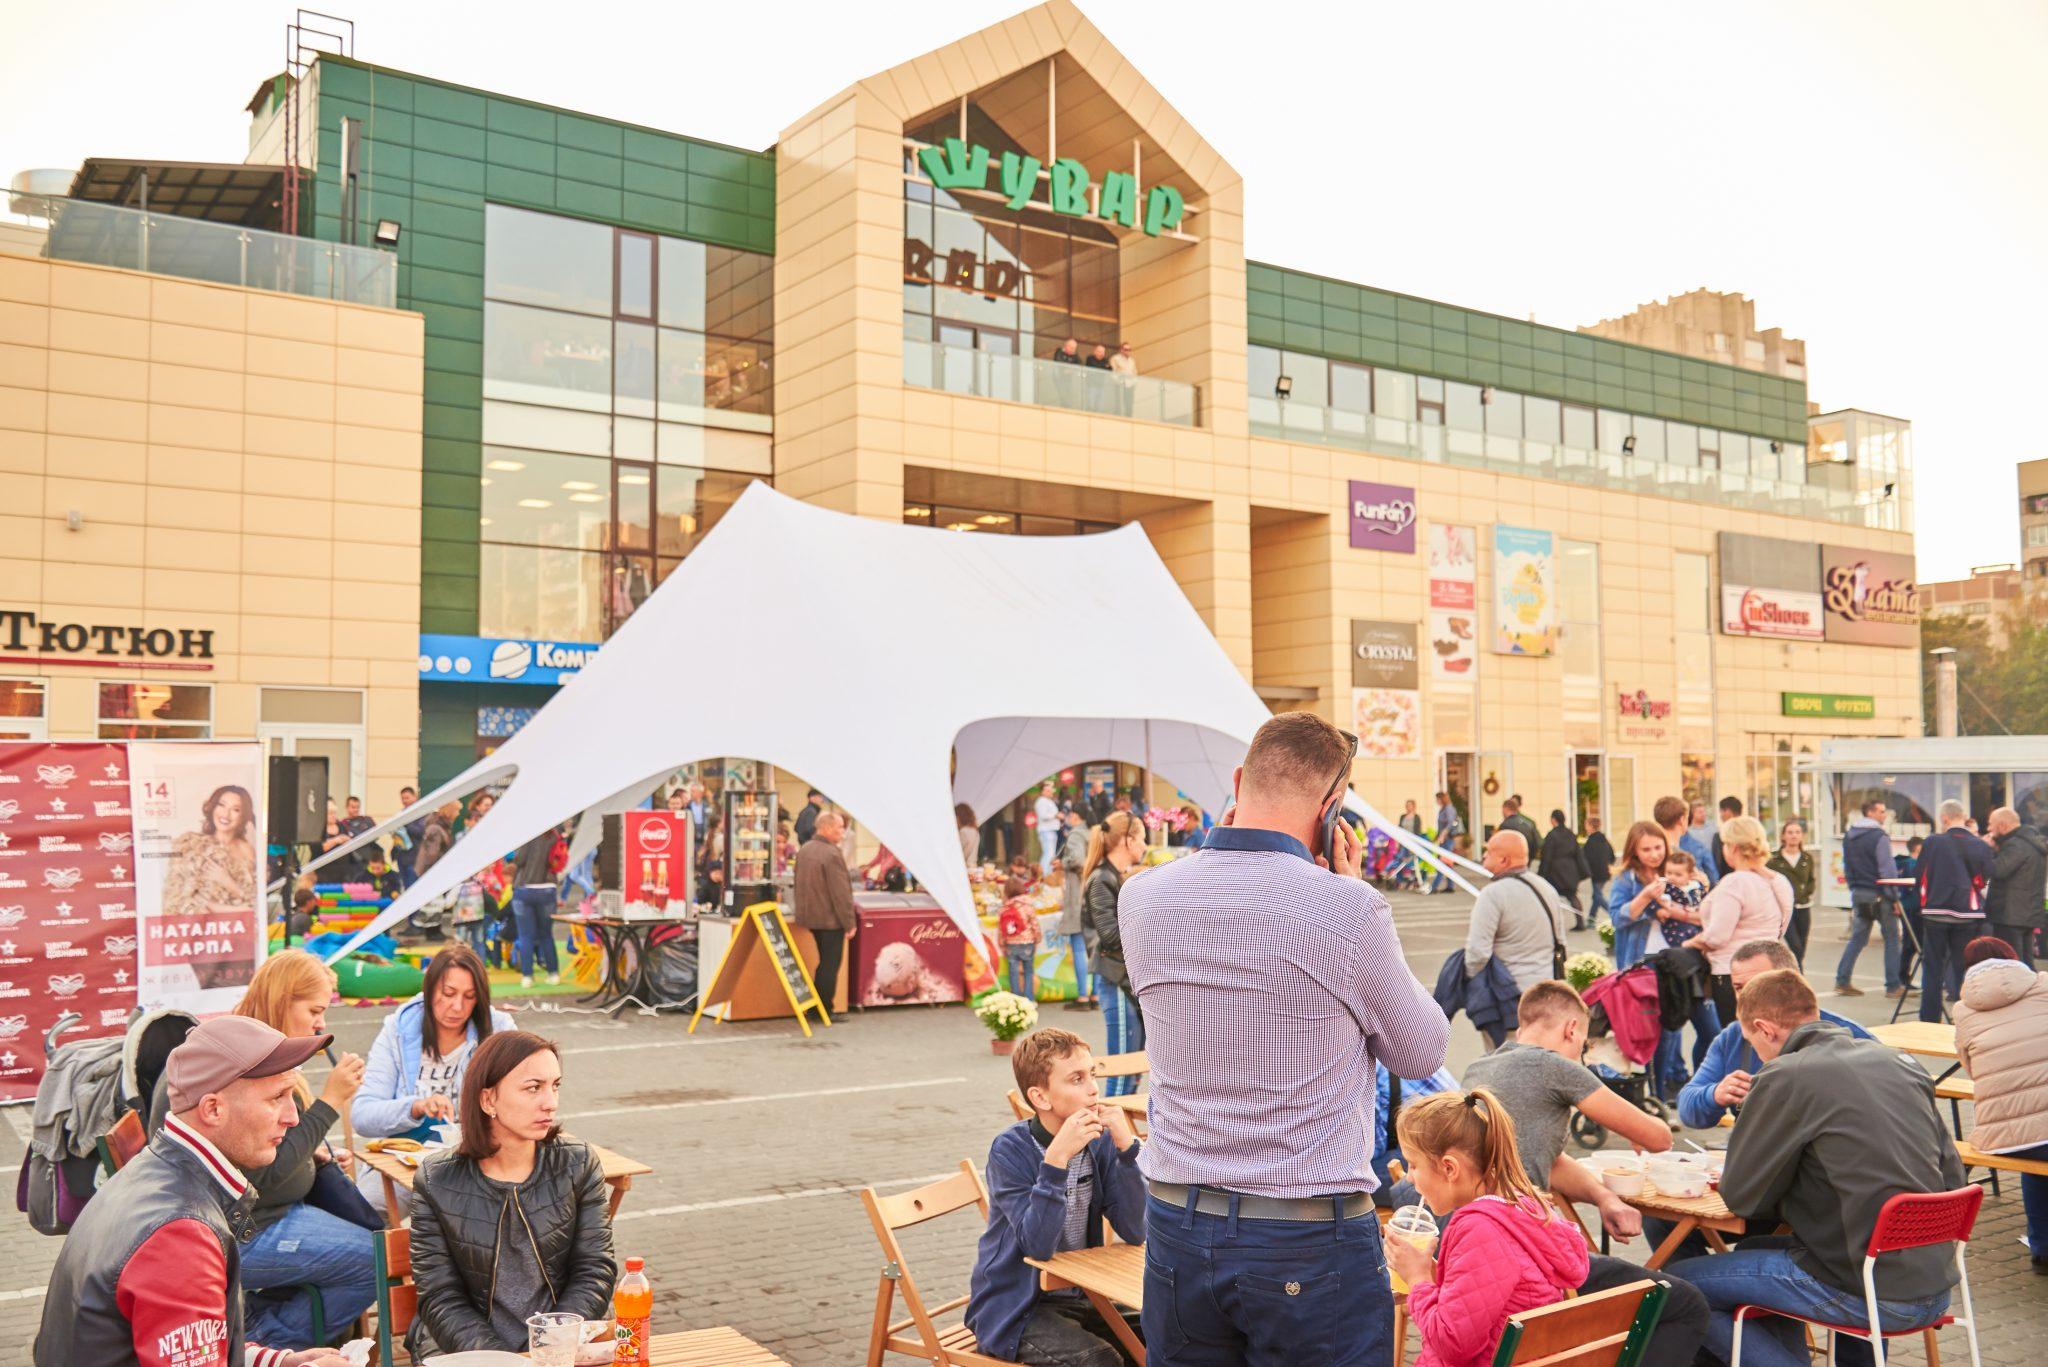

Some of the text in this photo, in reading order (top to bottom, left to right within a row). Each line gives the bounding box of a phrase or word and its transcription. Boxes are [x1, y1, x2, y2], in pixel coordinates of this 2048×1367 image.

[918, 138, 1184, 237] ШУВАР
[144, 782, 169, 798] 14
[149, 920, 246, 939] НАТАЛКА
[163, 939, 234, 958] КАРПА
